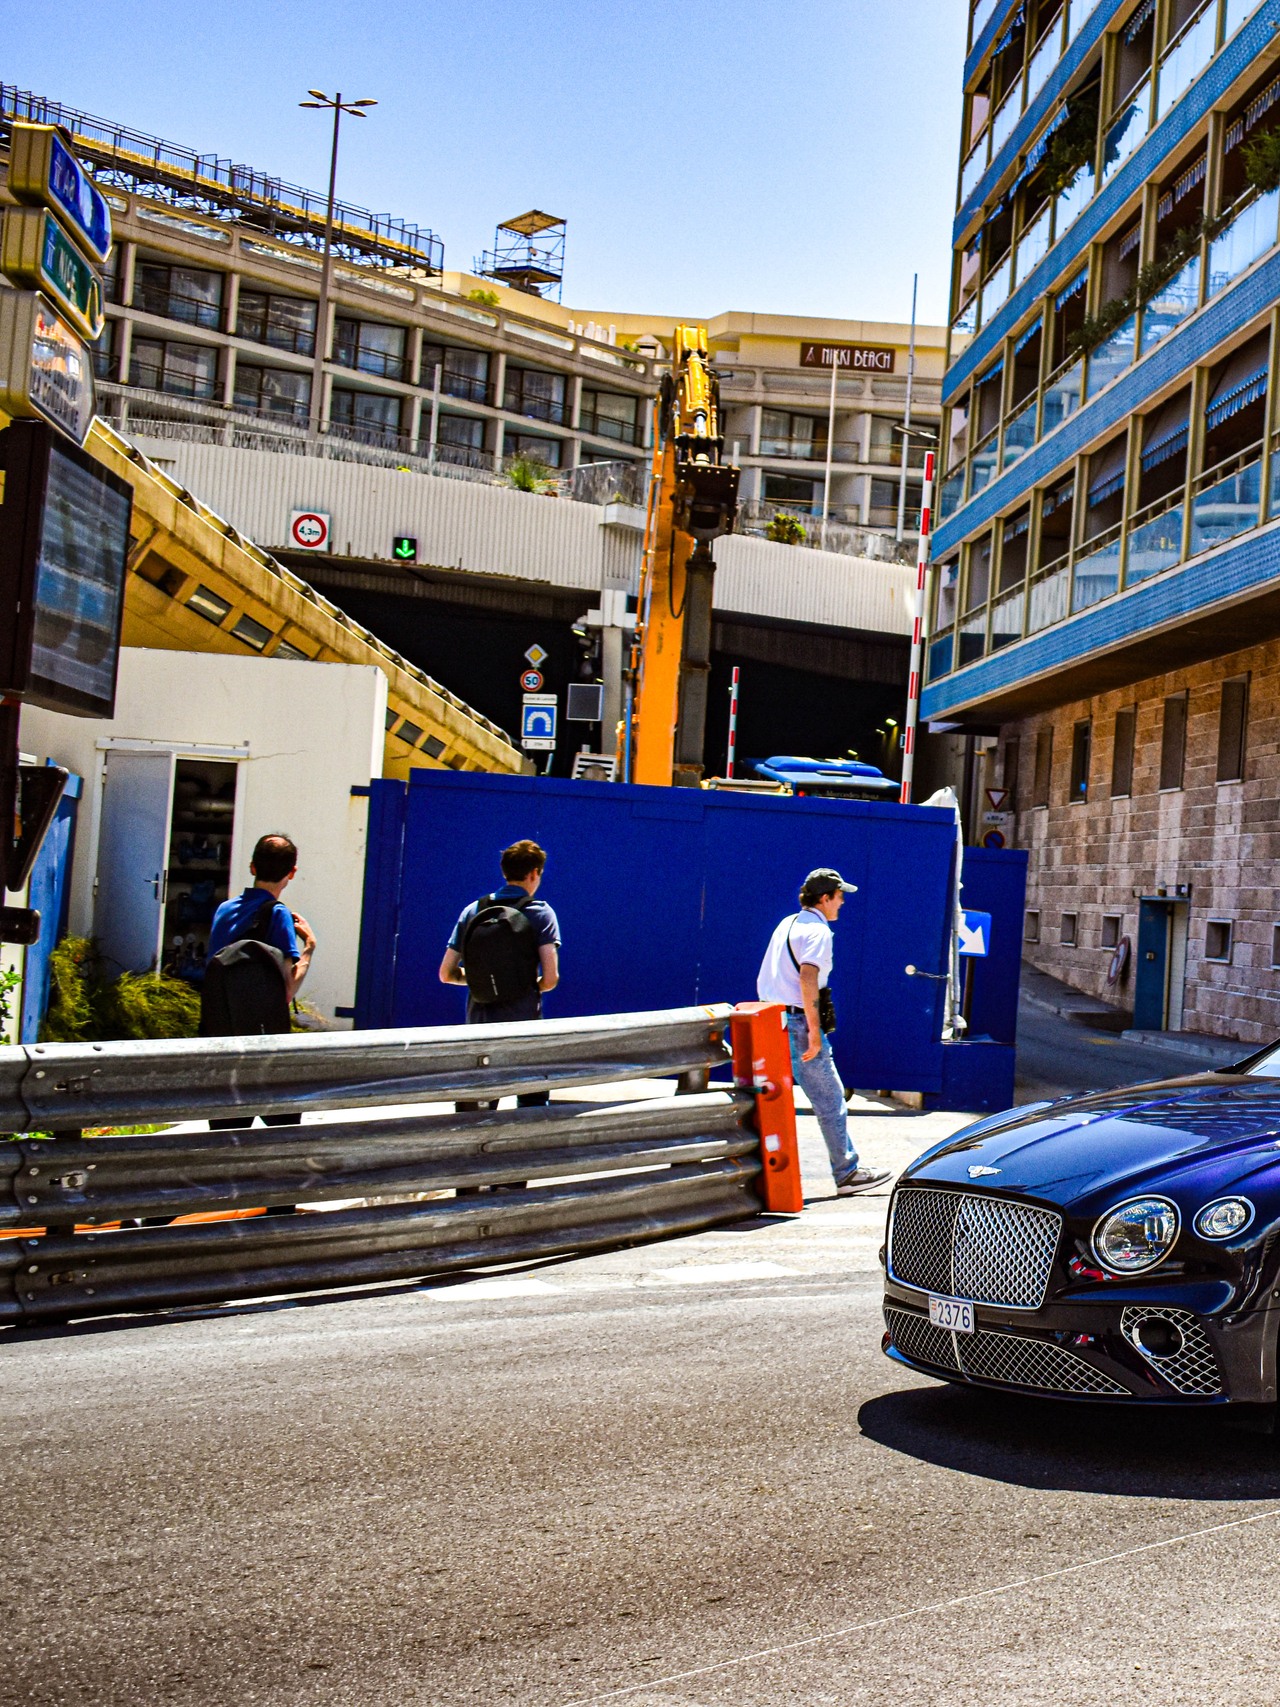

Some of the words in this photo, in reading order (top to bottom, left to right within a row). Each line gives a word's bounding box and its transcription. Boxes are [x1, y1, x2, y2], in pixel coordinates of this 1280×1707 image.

[821, 347, 850, 366] NIKKI
[853, 350, 891, 369] BEACH
[299, 525, 320, 536] 4,3m
[525, 676, 539, 686] 50
[826, 790, 879, 800] Mercedes-Benz
[937, 1301, 971, 1329] 2376
